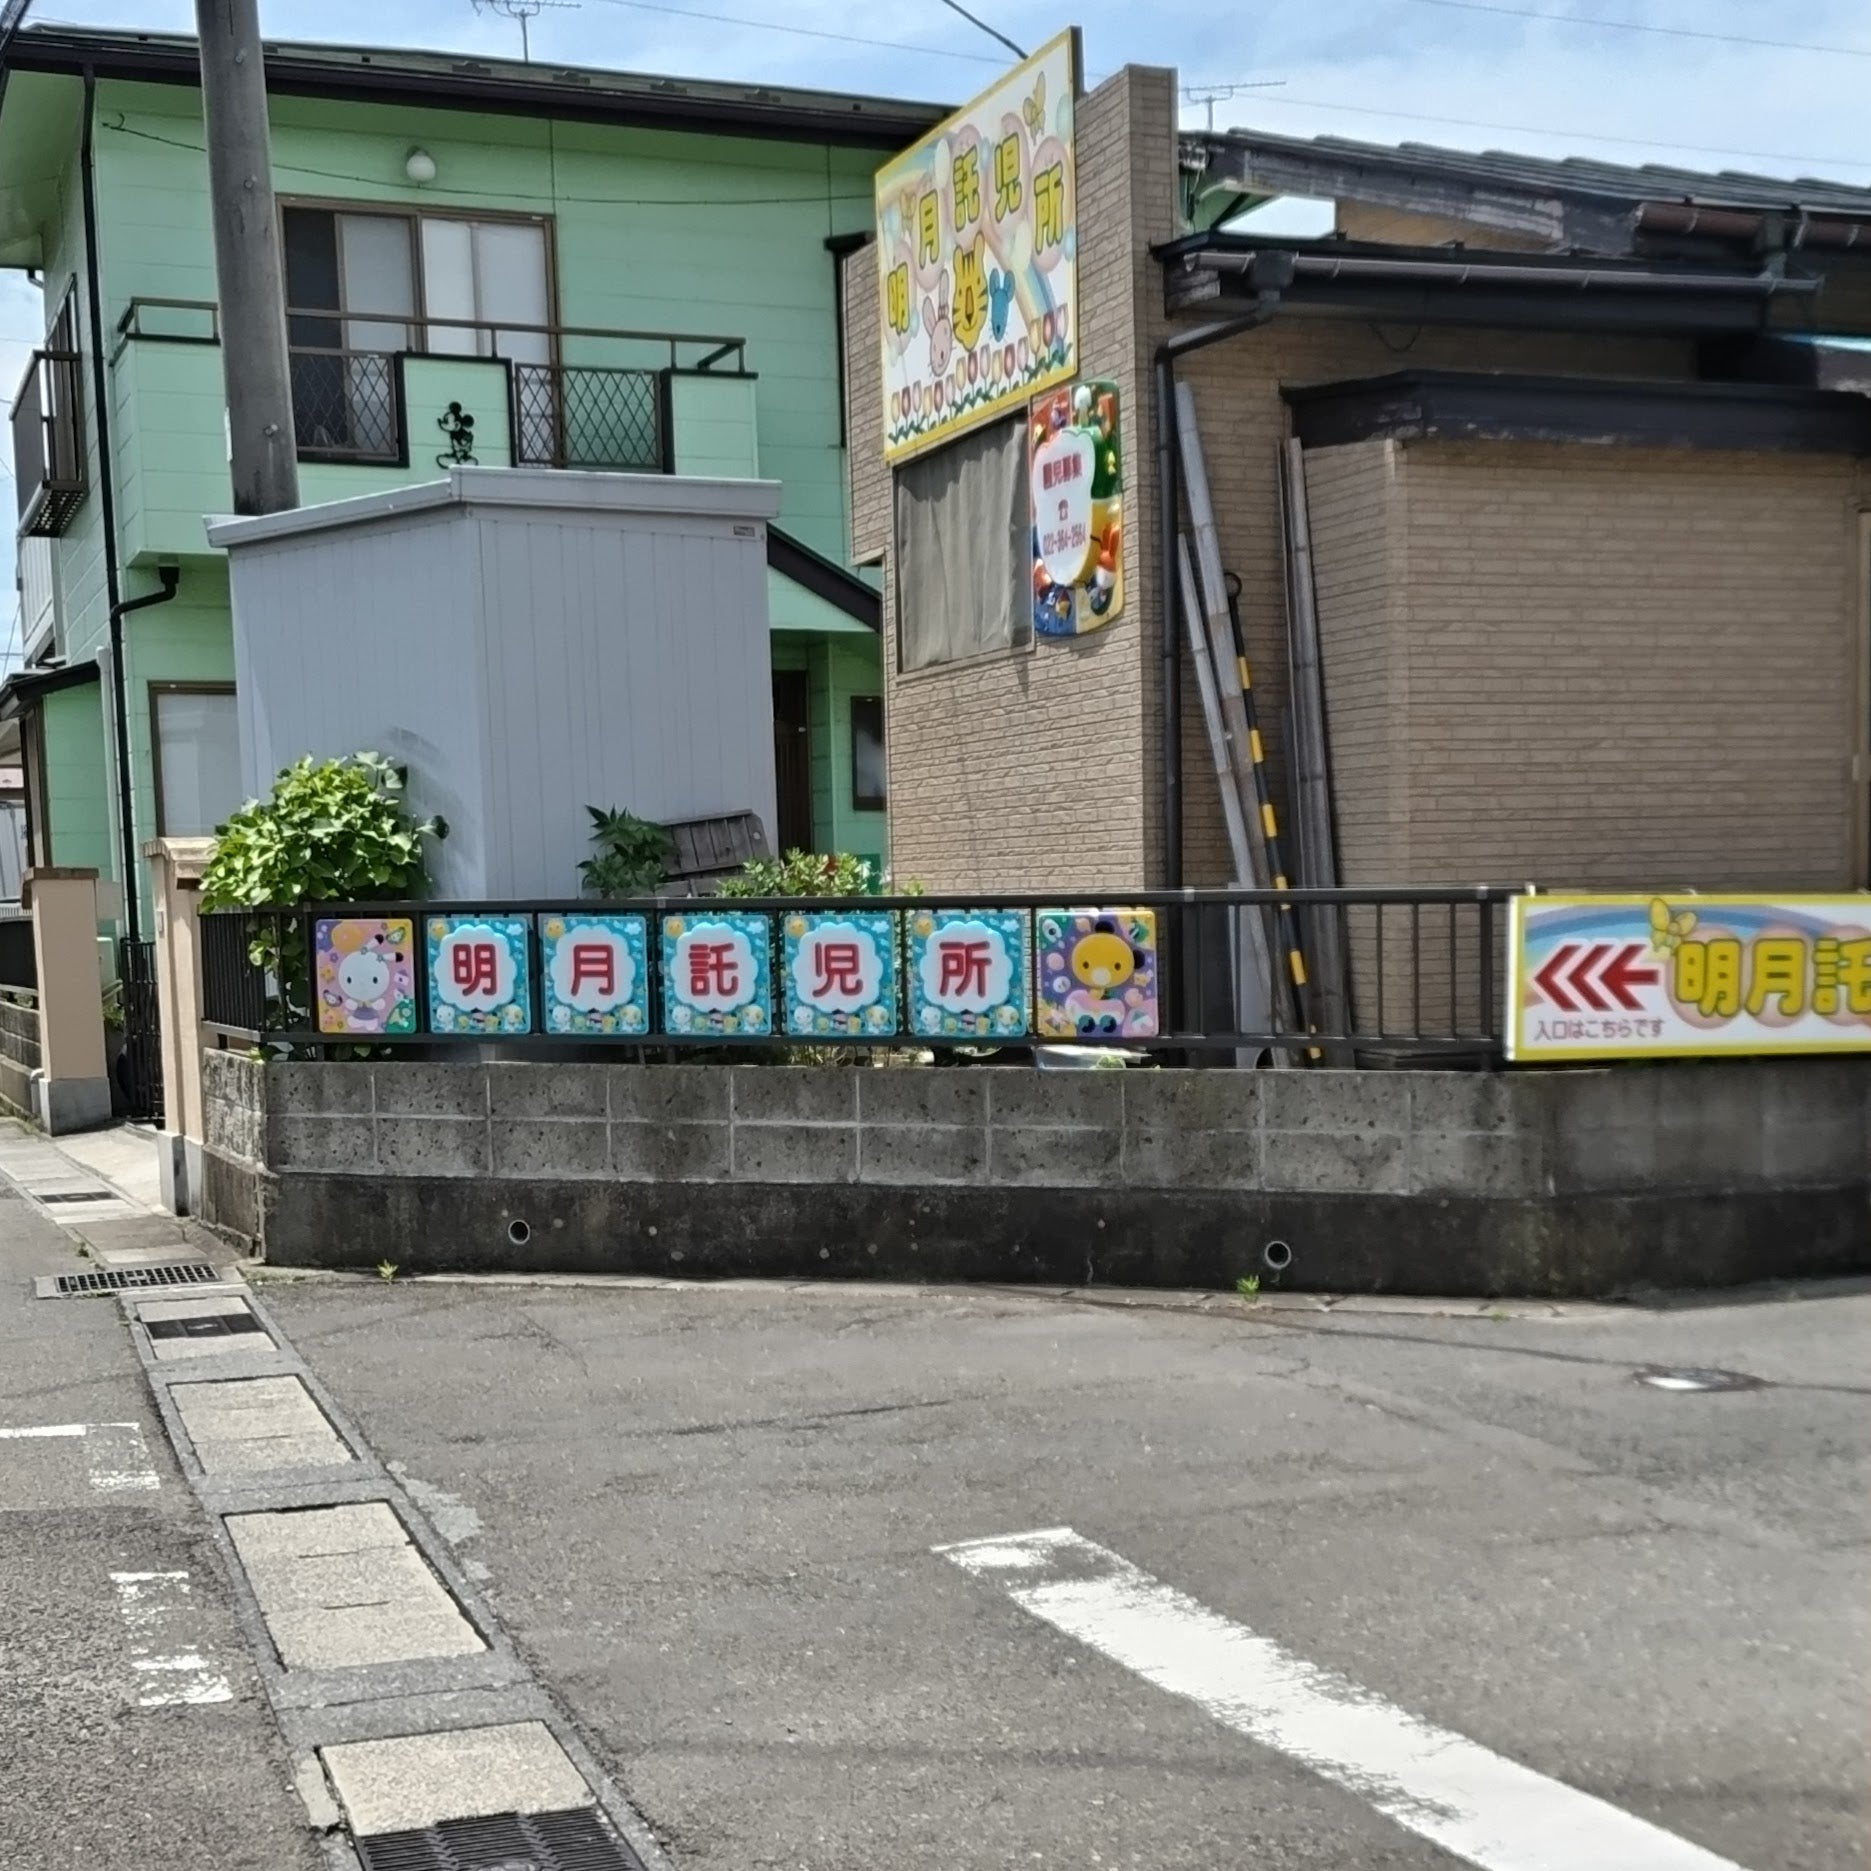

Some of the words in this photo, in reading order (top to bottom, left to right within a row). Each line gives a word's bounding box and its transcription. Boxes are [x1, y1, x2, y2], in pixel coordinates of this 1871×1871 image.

[887, 131, 1065, 336] 明月託児所
[1534, 1018, 1664, 1042] 入口はこちらです
